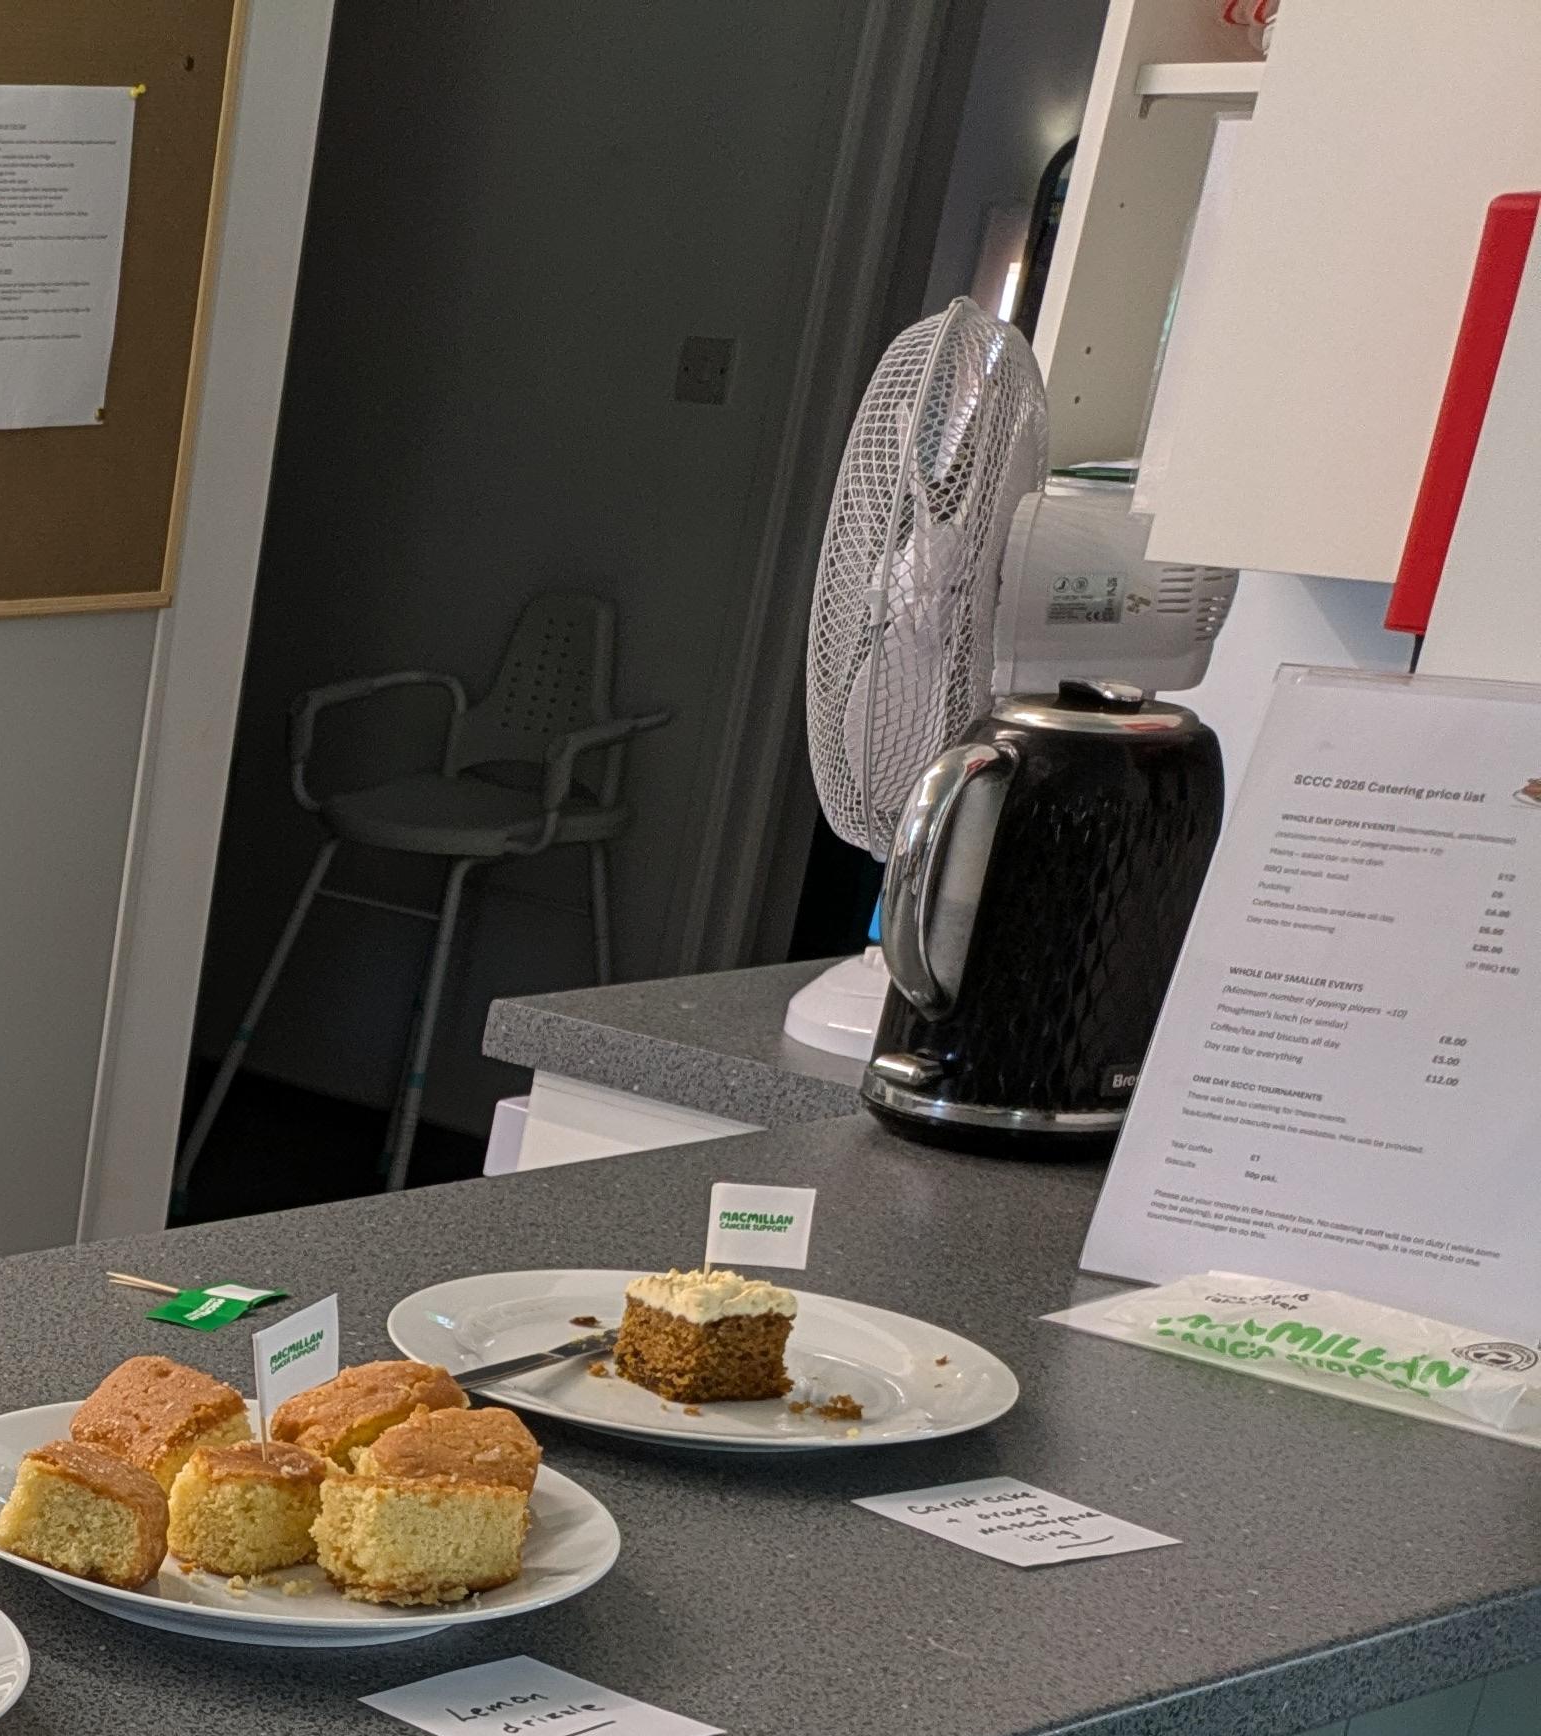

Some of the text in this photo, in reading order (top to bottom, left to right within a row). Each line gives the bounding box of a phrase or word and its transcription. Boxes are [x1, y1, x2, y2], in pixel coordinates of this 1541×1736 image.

[1292, 773, 1486, 803] SCCC 2026 Catering price list
[1227, 965, 1364, 992] WHOLE DAY SMALLER EVENTS
[719, 1210, 794, 1225] MACMILLAN
[719, 1221, 788, 1233] CANCER SUPPORT
[269, 1329, 324, 1366] MACMILLAN
[270, 1342, 321, 1375] CANCER SUPPORT
[907, 1490, 1038, 1515] Carrot cake
[977, 1504, 1050, 1520] orange
[1018, 1529, 1082, 1543] icing
[445, 1692, 549, 1722] Lemon
[503, 1703, 606, 1734] drizzle
